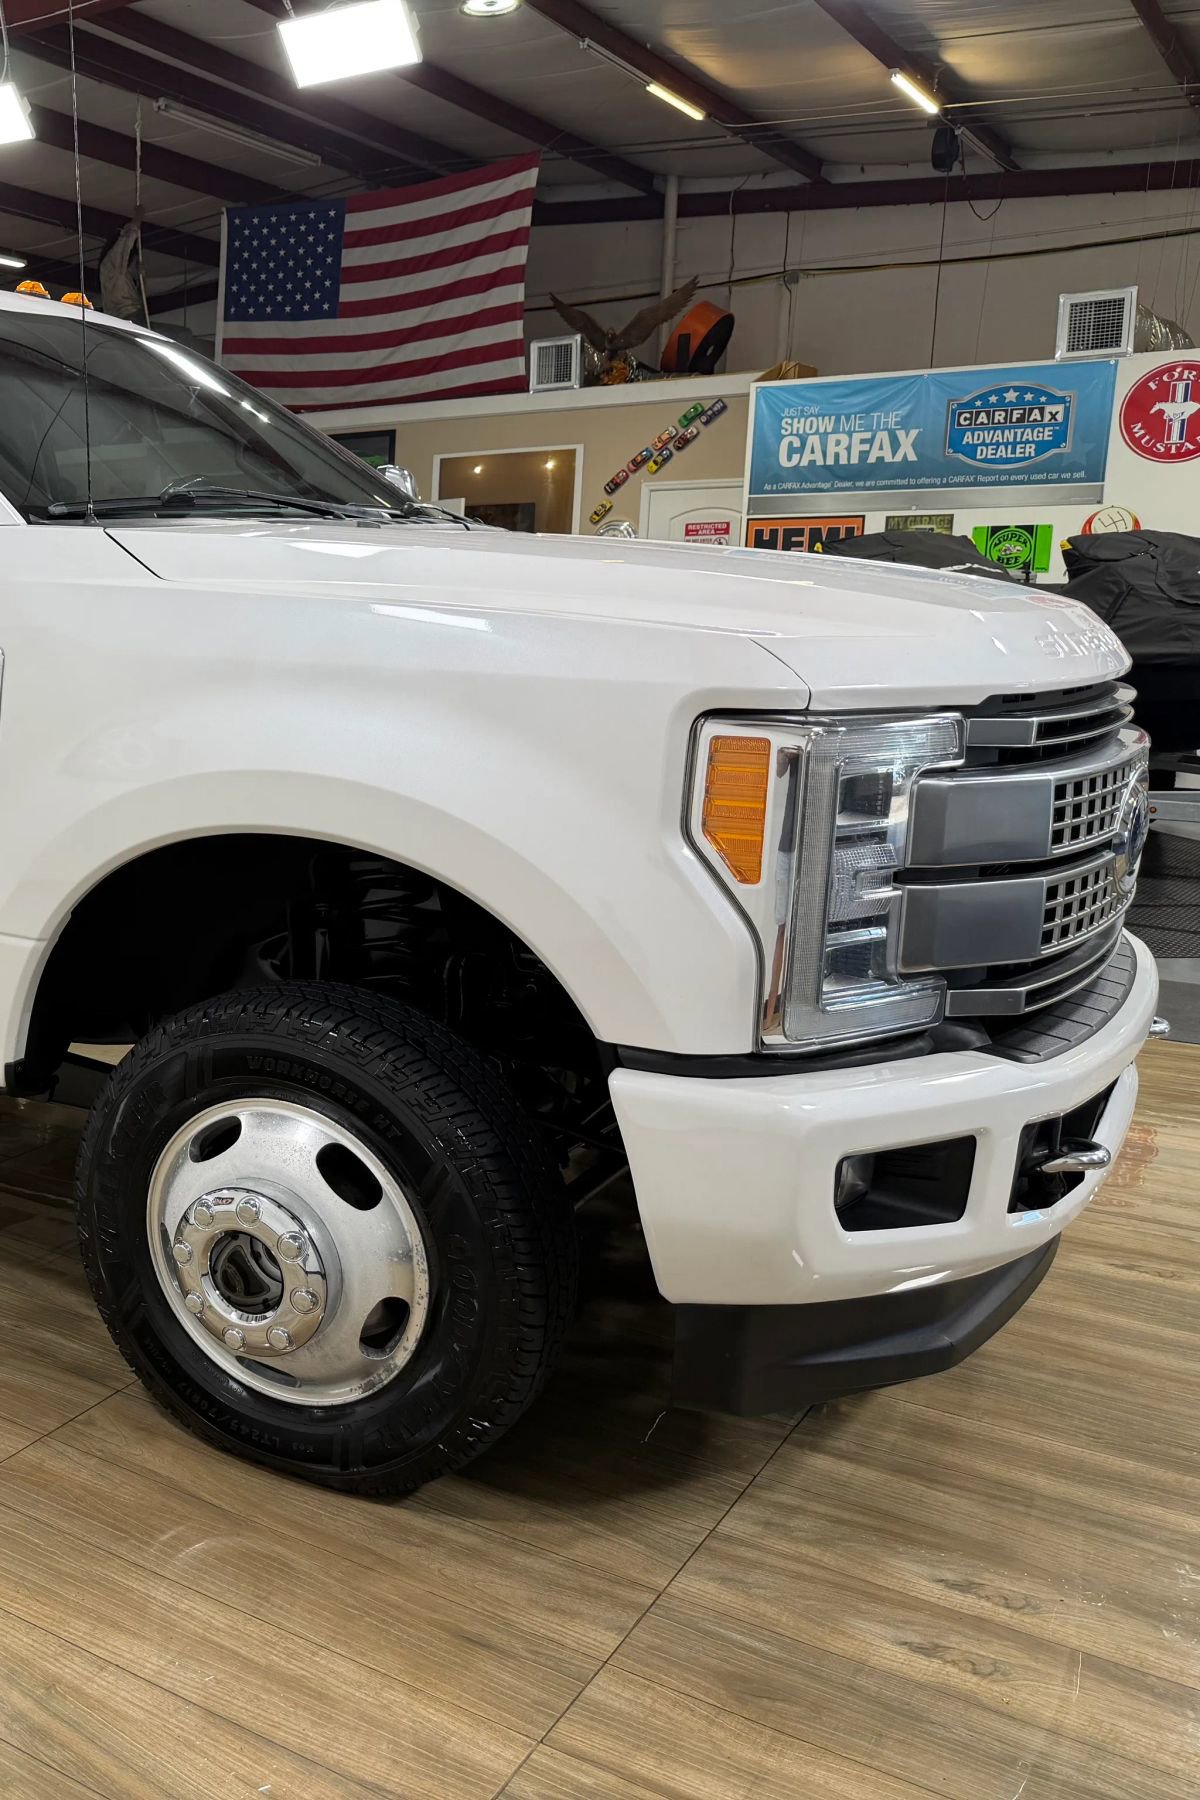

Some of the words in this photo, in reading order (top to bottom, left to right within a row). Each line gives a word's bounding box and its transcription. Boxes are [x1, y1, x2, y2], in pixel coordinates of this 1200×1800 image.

[1147, 368, 1200, 391] FOR
[782, 407, 801, 417] JUST
[803, 406, 820, 415] SAY
[958, 407, 1060, 425] CARFAX
[781, 416, 836, 435] SHOW
[839, 413, 866, 432] ME
[870, 411, 902, 430] THE
[962, 427, 1054, 445] ADVANTAGE
[1131, 423, 1200, 454] MUSTA
[778, 428, 920, 468] CARFAX
[976, 443, 1036, 459] DEALER
[777, 482, 801, 490] CARFAX
[801, 481, 831, 490] Advantage
[876, 477, 909, 486] committed
[909, 477, 916, 485] to
[917, 476, 941, 485] offering
[948, 475, 973, 484] CARFAX
[977, 474, 999, 483] Report
[1010, 474, 1028, 482] every
[1029, 472, 1047, 480] used
[1073, 471, 1087, 479] sell.
[887, 516, 905, 530] MY
[907, 515, 951, 528] GARAGE
[993, 533, 1029, 548] SUPER
[996, 556, 1022, 566] BEE
